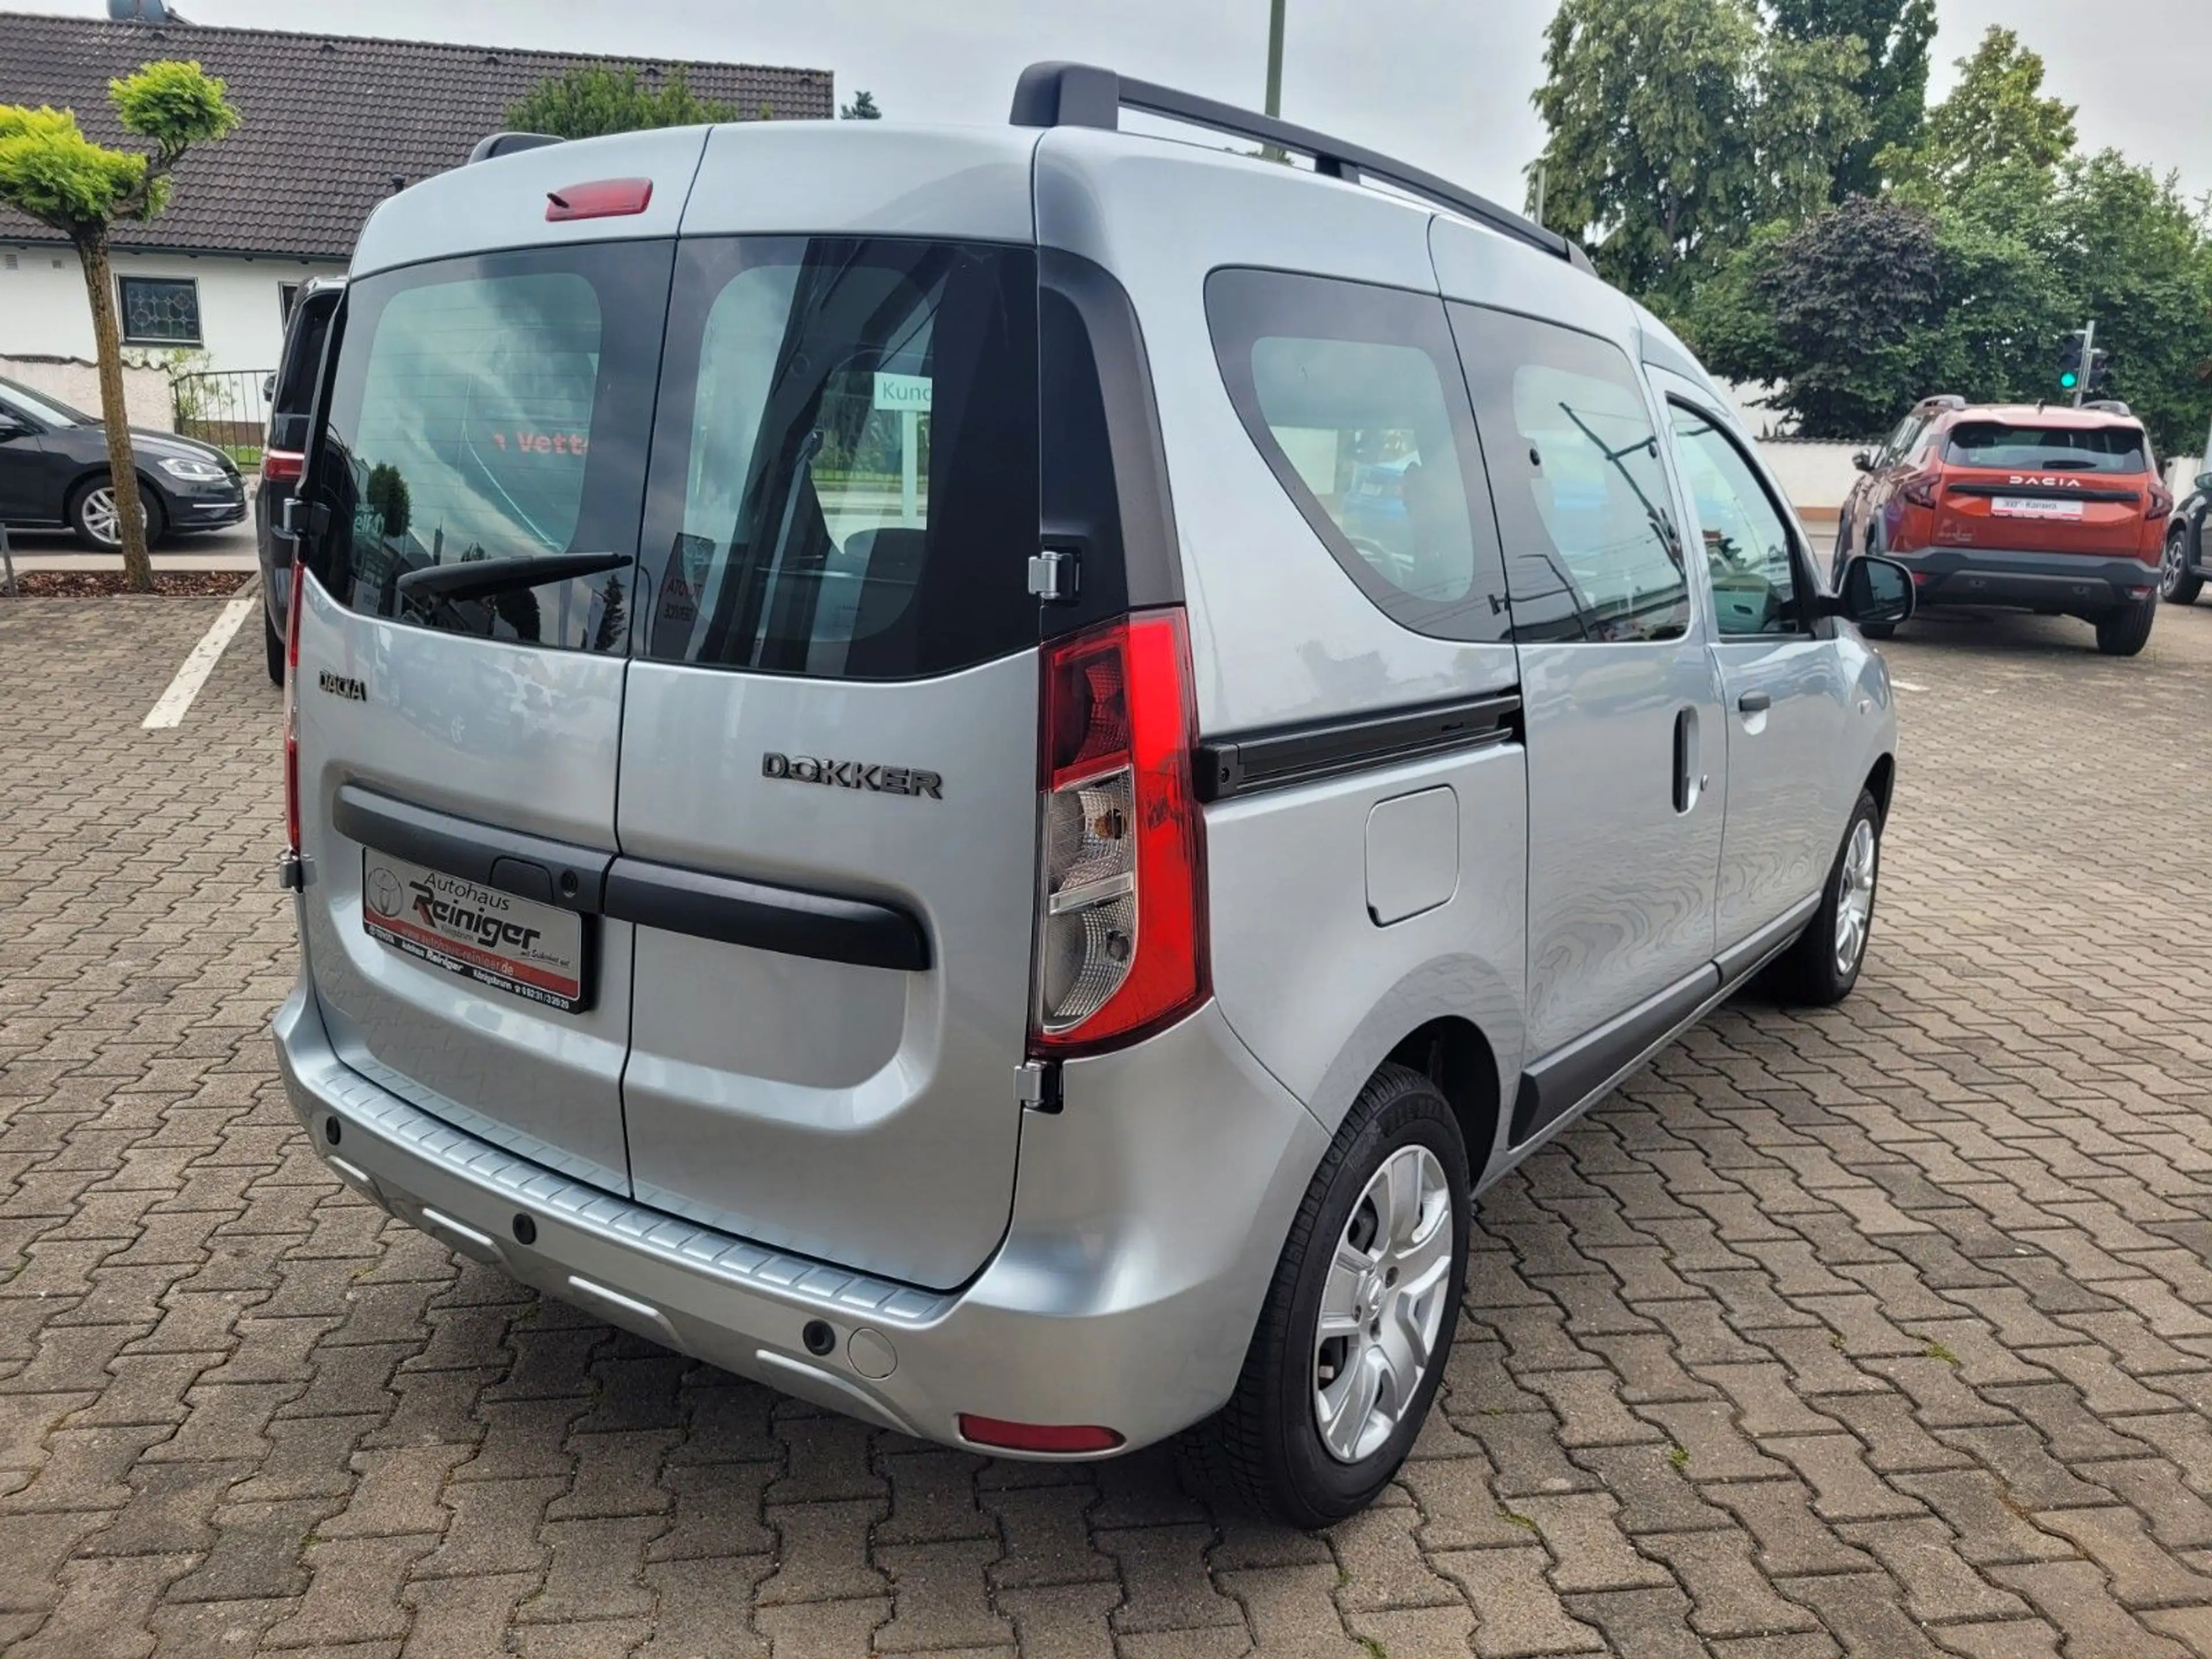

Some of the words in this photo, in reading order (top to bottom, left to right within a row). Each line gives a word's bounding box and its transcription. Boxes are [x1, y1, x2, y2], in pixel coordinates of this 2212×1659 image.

[2009, 475, 2081, 487] DACIA
[319, 669, 367, 702] DACIA
[762, 751, 943, 800] DOKKER
[423, 872, 510, 911] Autohaus
[409, 881, 541, 948] Reiniger
[426, 950, 464, 972] Reiniger
